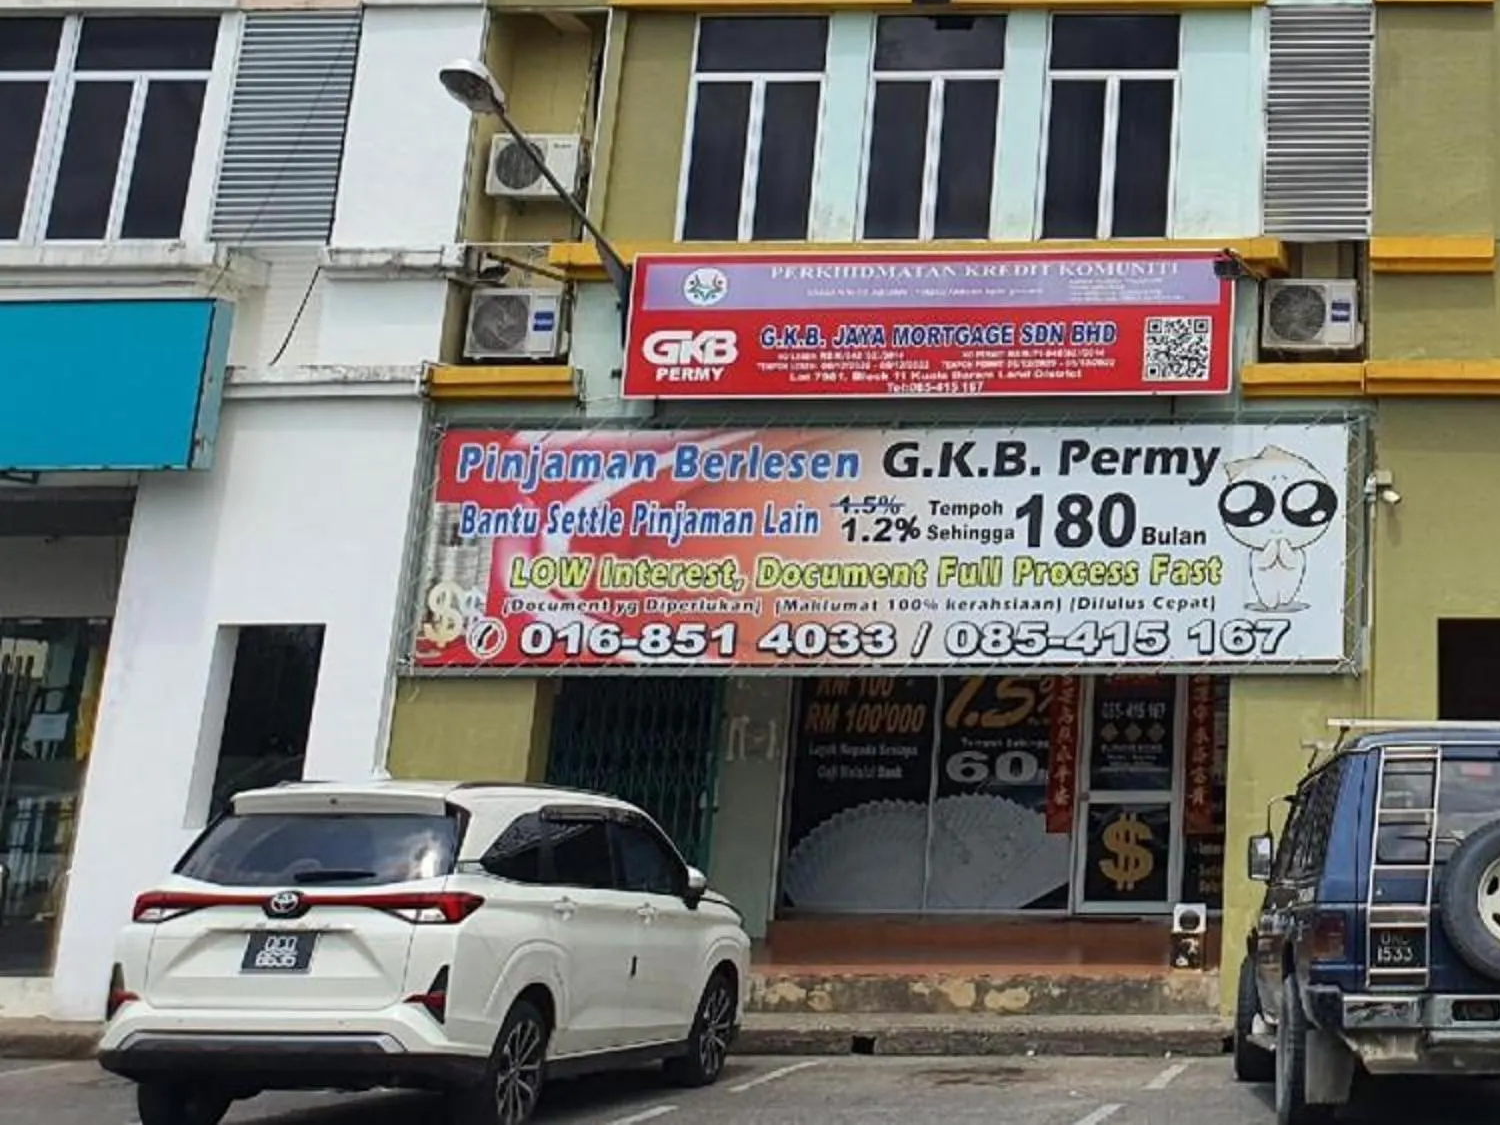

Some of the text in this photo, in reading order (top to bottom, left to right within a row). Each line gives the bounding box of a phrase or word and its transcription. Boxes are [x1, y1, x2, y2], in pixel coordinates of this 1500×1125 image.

[771, 260, 1179, 280] PERKHIDMATAN KREDIT KOMUNITI
[642, 330, 739, 366] GKB
[760, 321, 1117, 349] G.K.B. JAYA MORTGAGE SDN BHD
[655, 366, 725, 382] PERMY
[457, 439, 1222, 492] Pinjaman Berlesen G.K.B. Permy
[837, 494, 901, 516] 1.5%
[927, 499, 1003, 518] Tempoh
[460, 501, 821, 547] Bantu Settle Pinjaman Lain
[841, 515, 921, 543] 1.2%
[927, 524, 1015, 544] Sehingga
[1015, 491, 1137, 549] 180
[1141, 526, 1207, 545] Bulan
[509, 554, 1224, 592] LOW Interest, Document Full Process Fast
[889, 598, 938, 612] 100%
[519, 618, 1291, 658] 016-851 4033 / 085-415 167
[805, 703, 928, 733] RM 100'000
[945, 750, 1039, 783] 60
